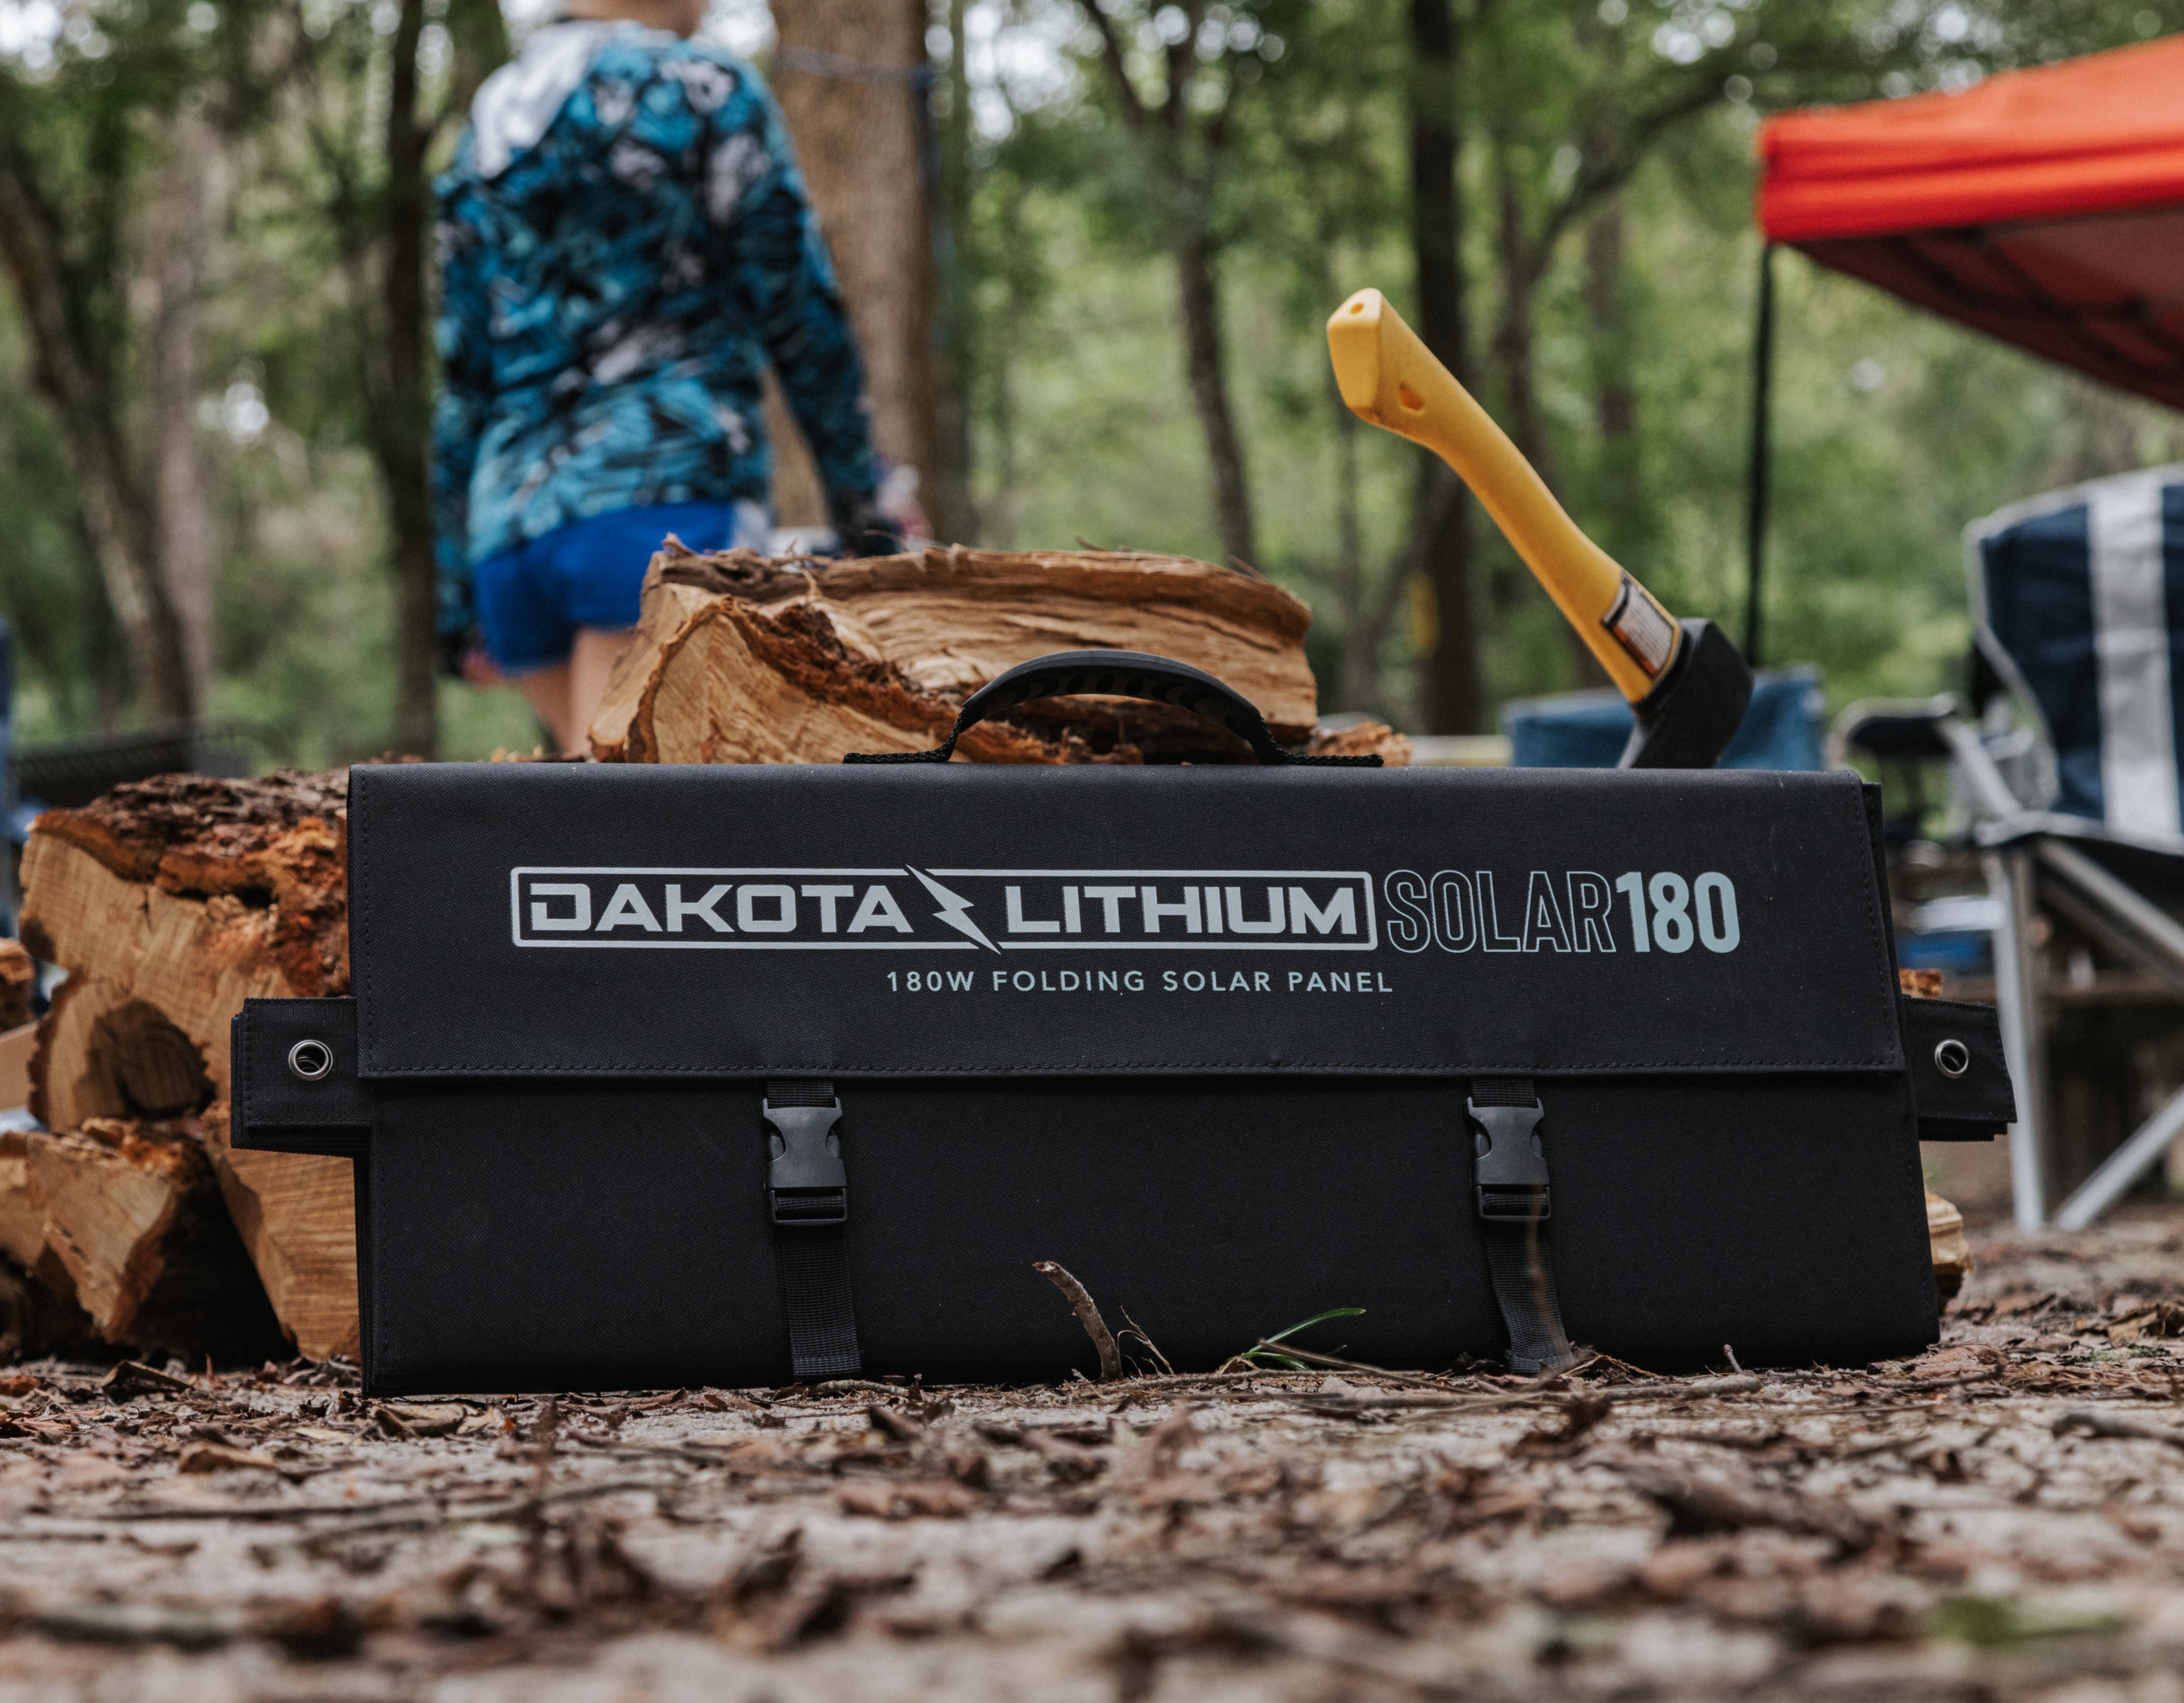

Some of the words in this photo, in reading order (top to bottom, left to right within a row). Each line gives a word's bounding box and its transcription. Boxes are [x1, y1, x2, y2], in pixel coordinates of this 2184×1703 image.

[529, 883, 914, 933] DAKOTA
[1005, 886, 1357, 935] LITHIUM
[887, 971, 974, 991] 180W
[992, 970, 1144, 991] FOLDING
[1162, 970, 1271, 991] SOLAR
[1288, 972, 1393, 992] PANEL
